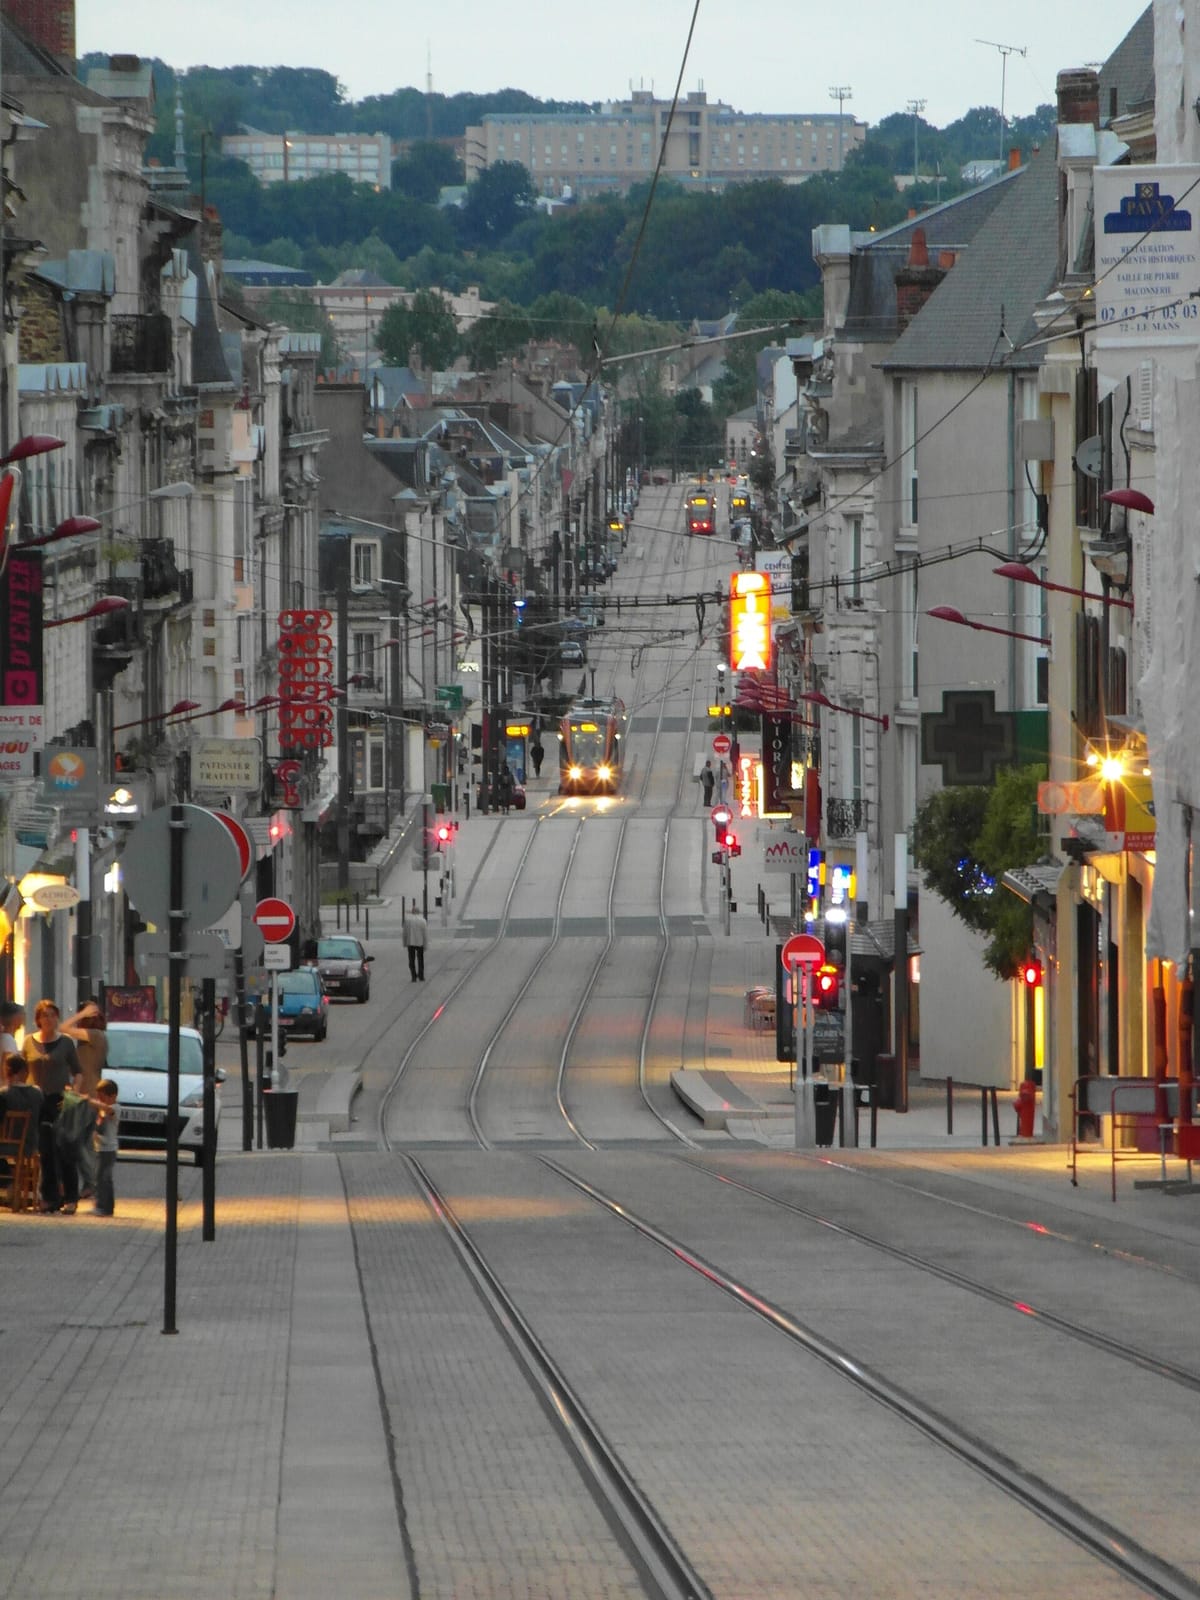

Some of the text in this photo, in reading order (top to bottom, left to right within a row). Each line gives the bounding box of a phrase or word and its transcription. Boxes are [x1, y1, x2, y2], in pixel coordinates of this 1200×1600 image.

[1127, 199, 1165, 216] PAVY
[1120, 244, 1175, 254] RESTAURATION
[1100, 254, 1196, 265] MONUMENTS HISTORIQUES
[1117, 271, 1180, 281] TAILLE DE PIERRE
[1101, 307, 1115, 321] 02
[1162, 303, 1177, 320] 03
[1183, 303, 1197, 319] 03
[1120, 323, 1128, 332] 72
[1136, 322, 1147, 331] LE
[1152, 321, 1180, 331] MANS
[764, 562, 791, 570] CENTRE
[736, 572, 767, 670] PIZZA
[28, 715, 42, 726] DE
[200, 772, 251, 781] TRAITEUR
[740, 757, 752, 817] PIZZA
